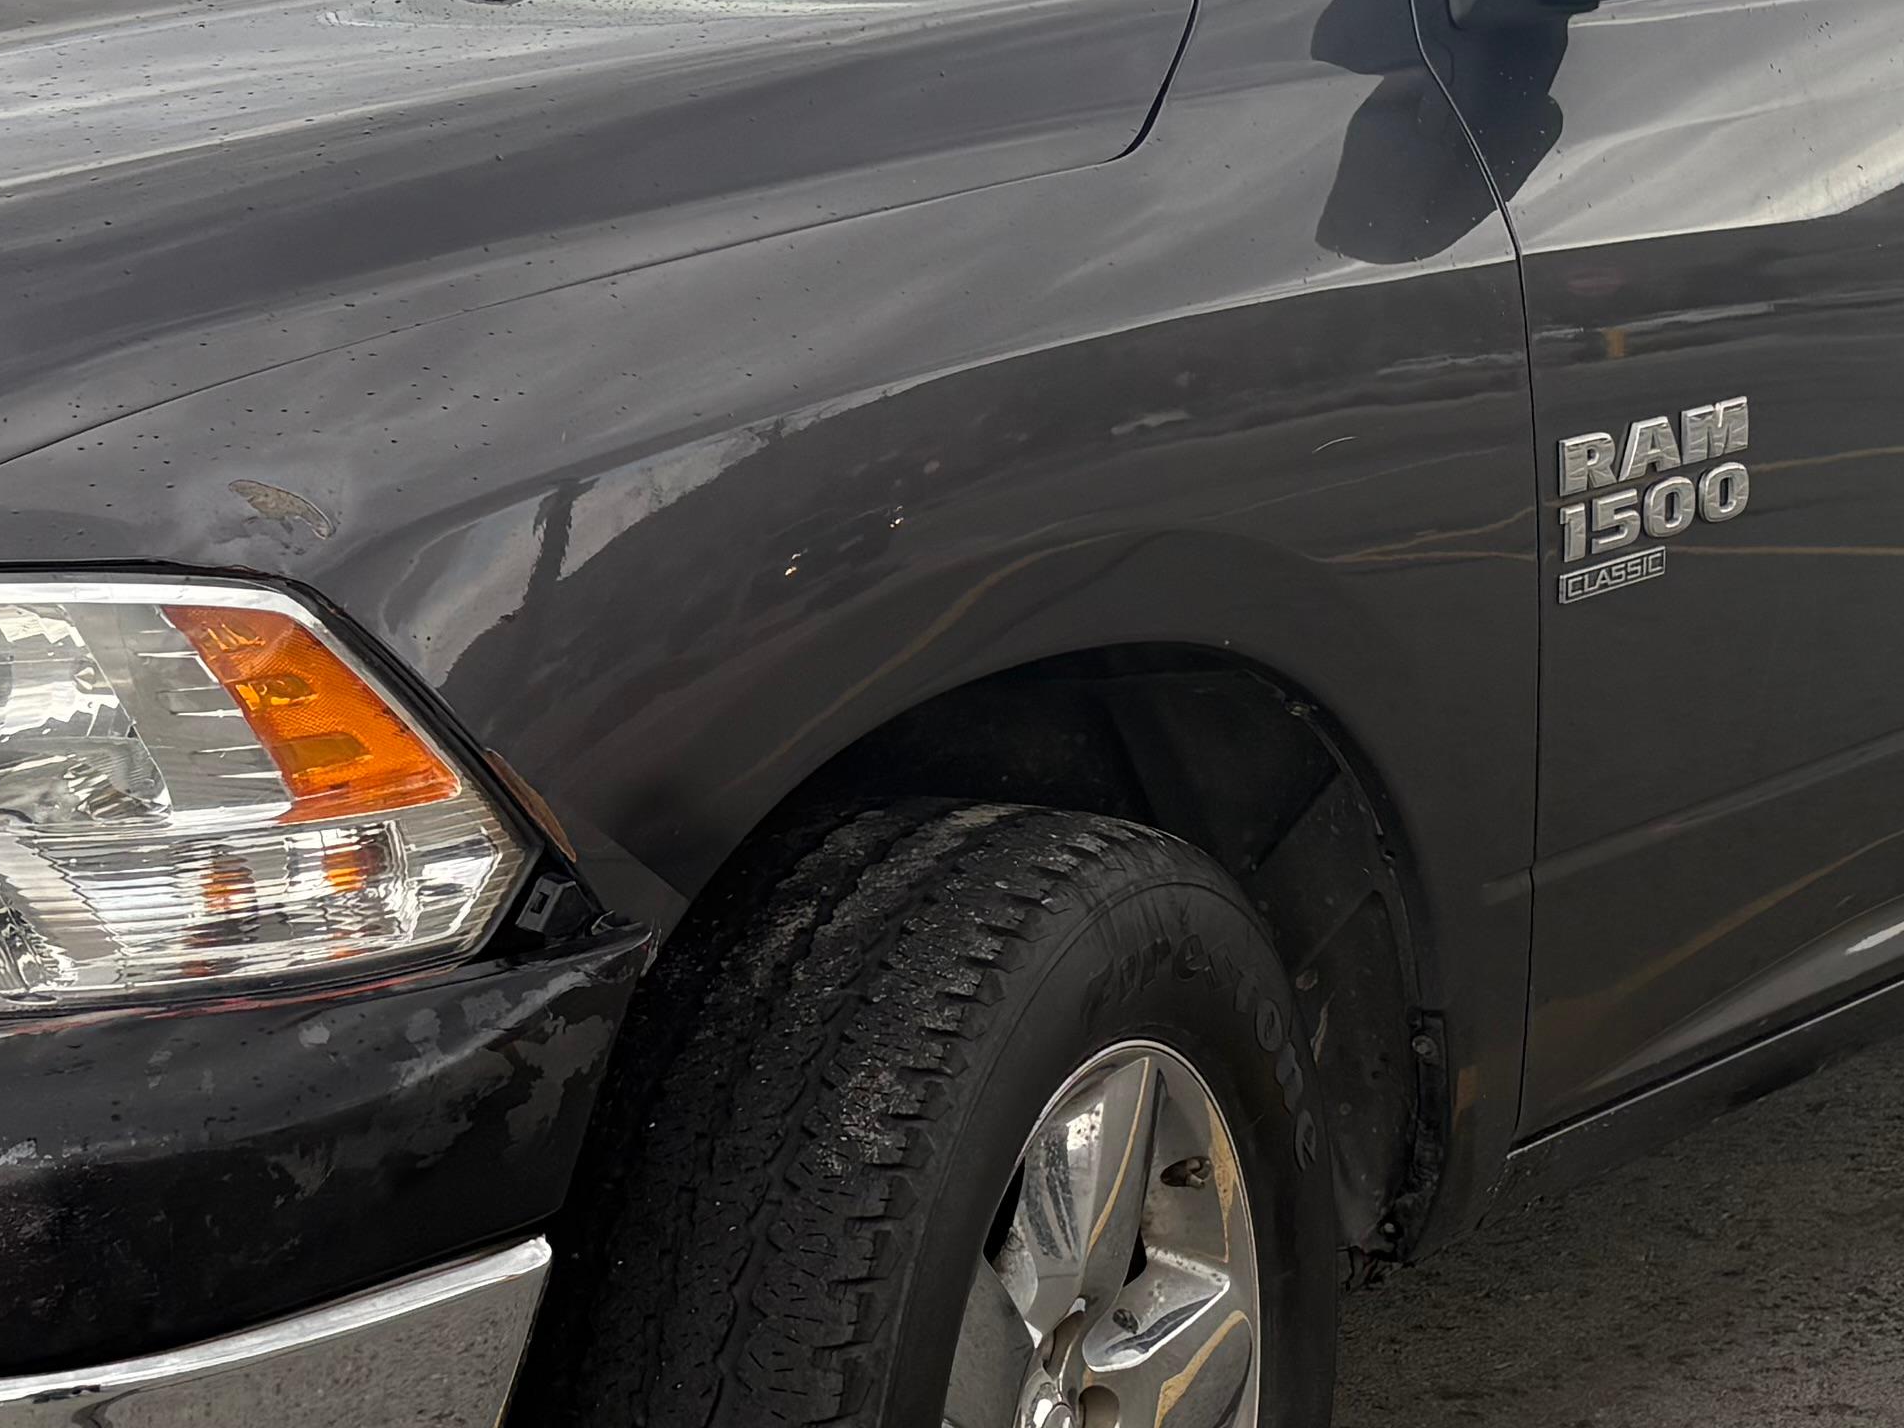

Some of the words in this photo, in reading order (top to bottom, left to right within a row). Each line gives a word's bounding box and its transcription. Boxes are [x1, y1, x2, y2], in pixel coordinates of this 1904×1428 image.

[1558, 396, 1749, 497] RAM
[1559, 462, 1749, 563] 1500
[1566, 552, 1665, 598] CLASSIC
